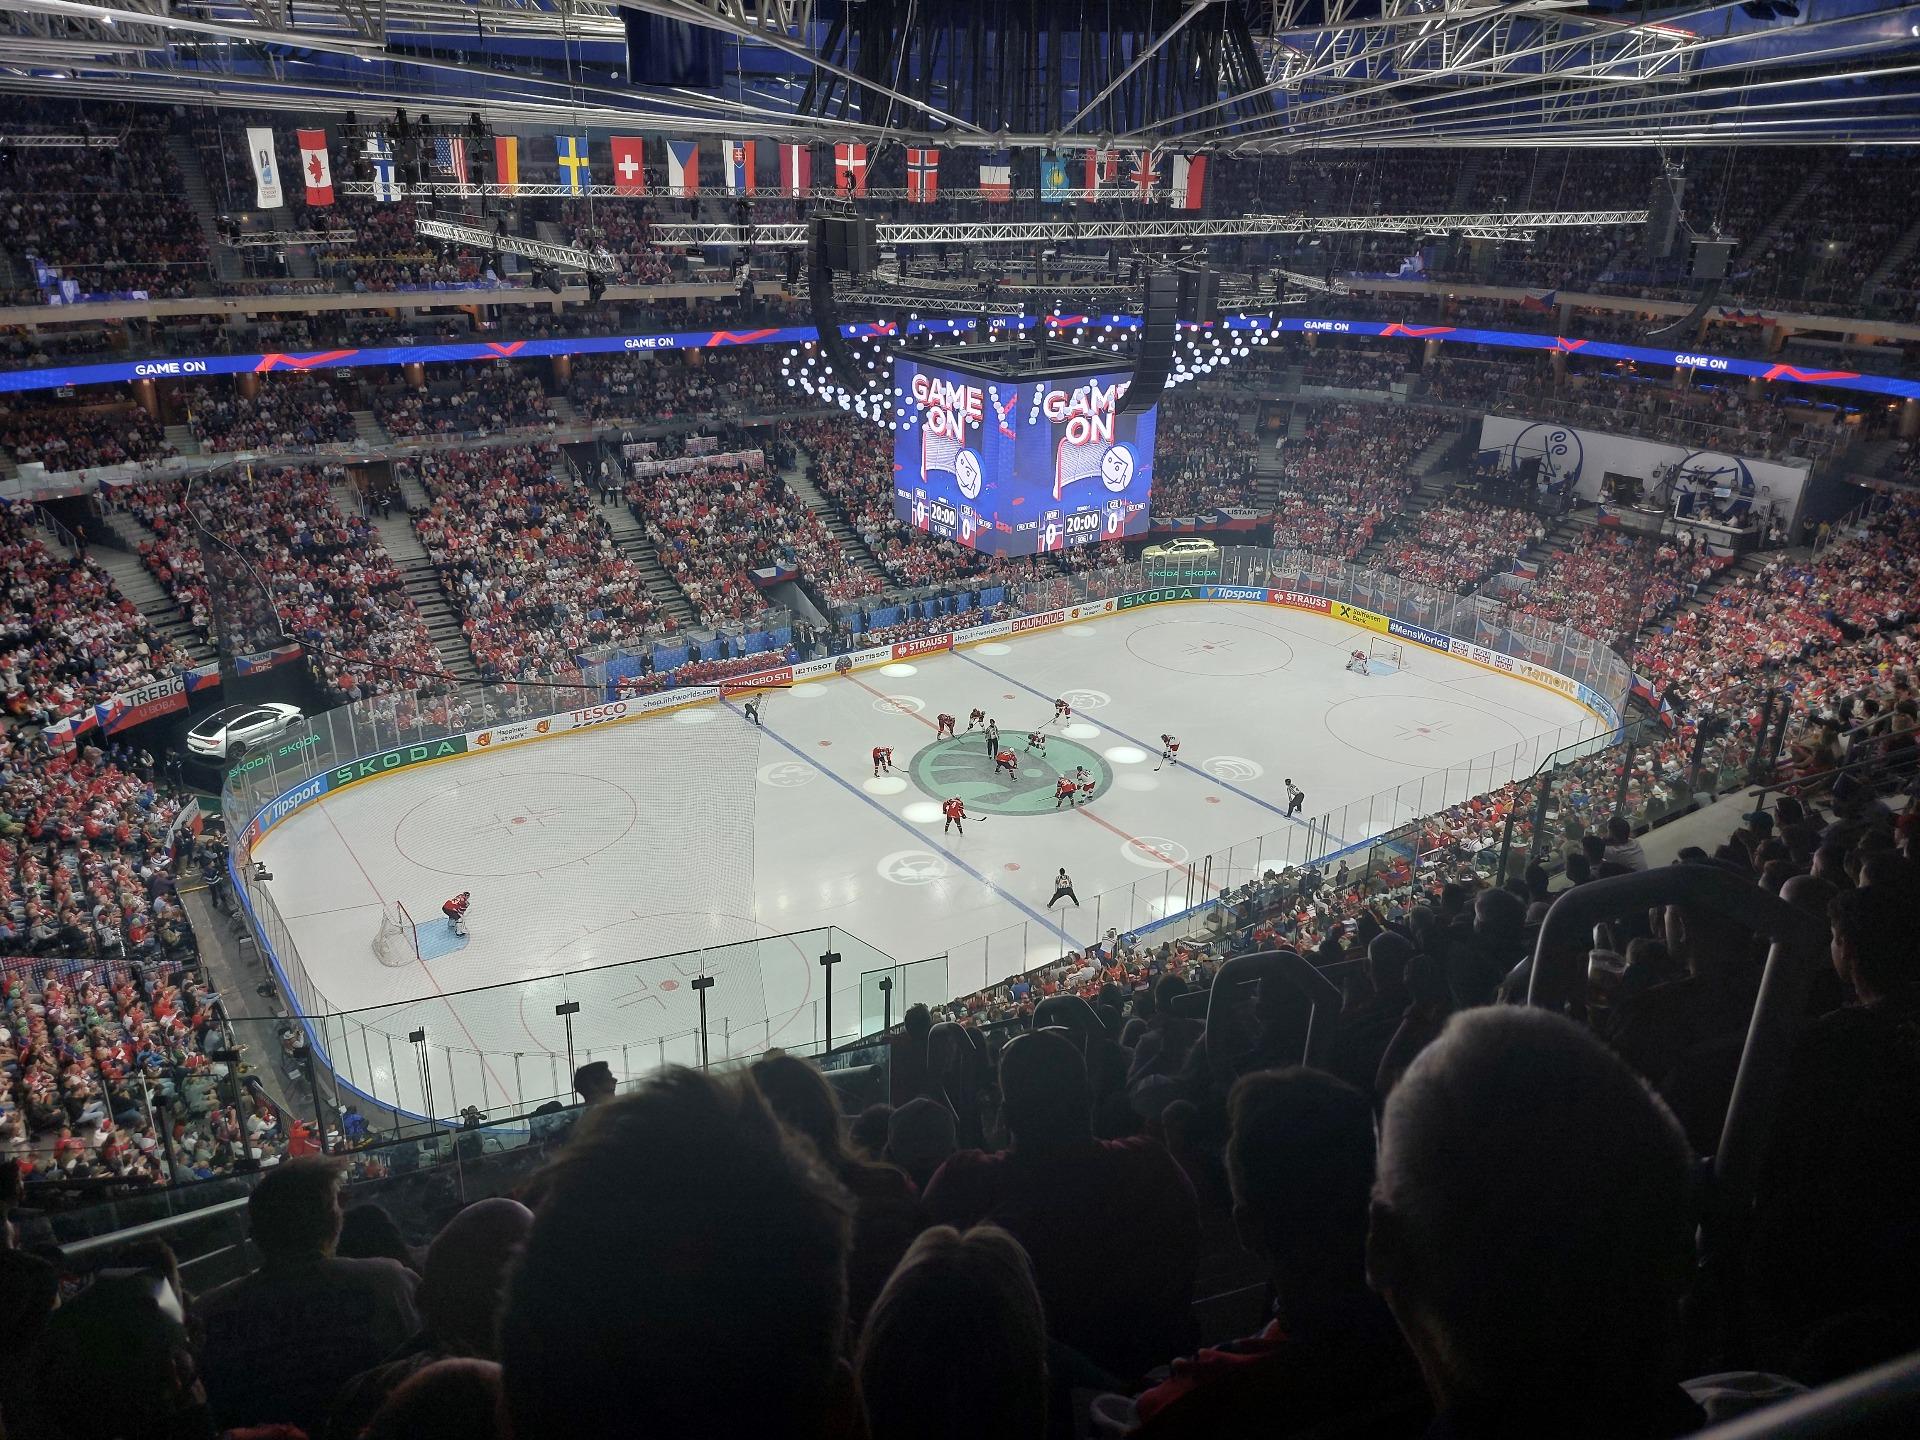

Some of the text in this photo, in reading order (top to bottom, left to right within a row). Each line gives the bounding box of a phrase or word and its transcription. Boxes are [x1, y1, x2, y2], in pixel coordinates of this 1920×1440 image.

[992, 318, 1006, 327] ON
[1303, 321, 1350, 331] GAME ON
[624, 337, 674, 348] GAME ON
[135, 361, 207, 376] GAME ON
[1675, 354, 1728, 370] GAME ON
[912, 373, 983, 421] GAME
[927, 406, 966, 444] ON
[1066, 412, 1114, 447] ON
[916, 501, 925, 522] 0
[931, 503, 955, 526] 20:00
[962, 518, 971, 541] 0
[1066, 513, 1099, 533] 20:00
[1107, 512, 1118, 534] 0
[1045, 523, 1056, 545] 0
[1217, 587, 1262, 600] Tipsport
[1286, 593, 1327, 608] STRAUSS
[1012, 612, 1065, 631] BAUHAUS
[909, 635, 948, 651] STRAUSS
[1390, 622, 1448, 649] #MensWorlds
[865, 650, 890, 660] TISSOT
[774, 671, 792, 681] STL
[806, 662, 832, 674] TISSOT
[1520, 663, 1577, 694] viamont
[570, 702, 627, 723] TESCO
[272, 779, 321, 819] Tipsport
